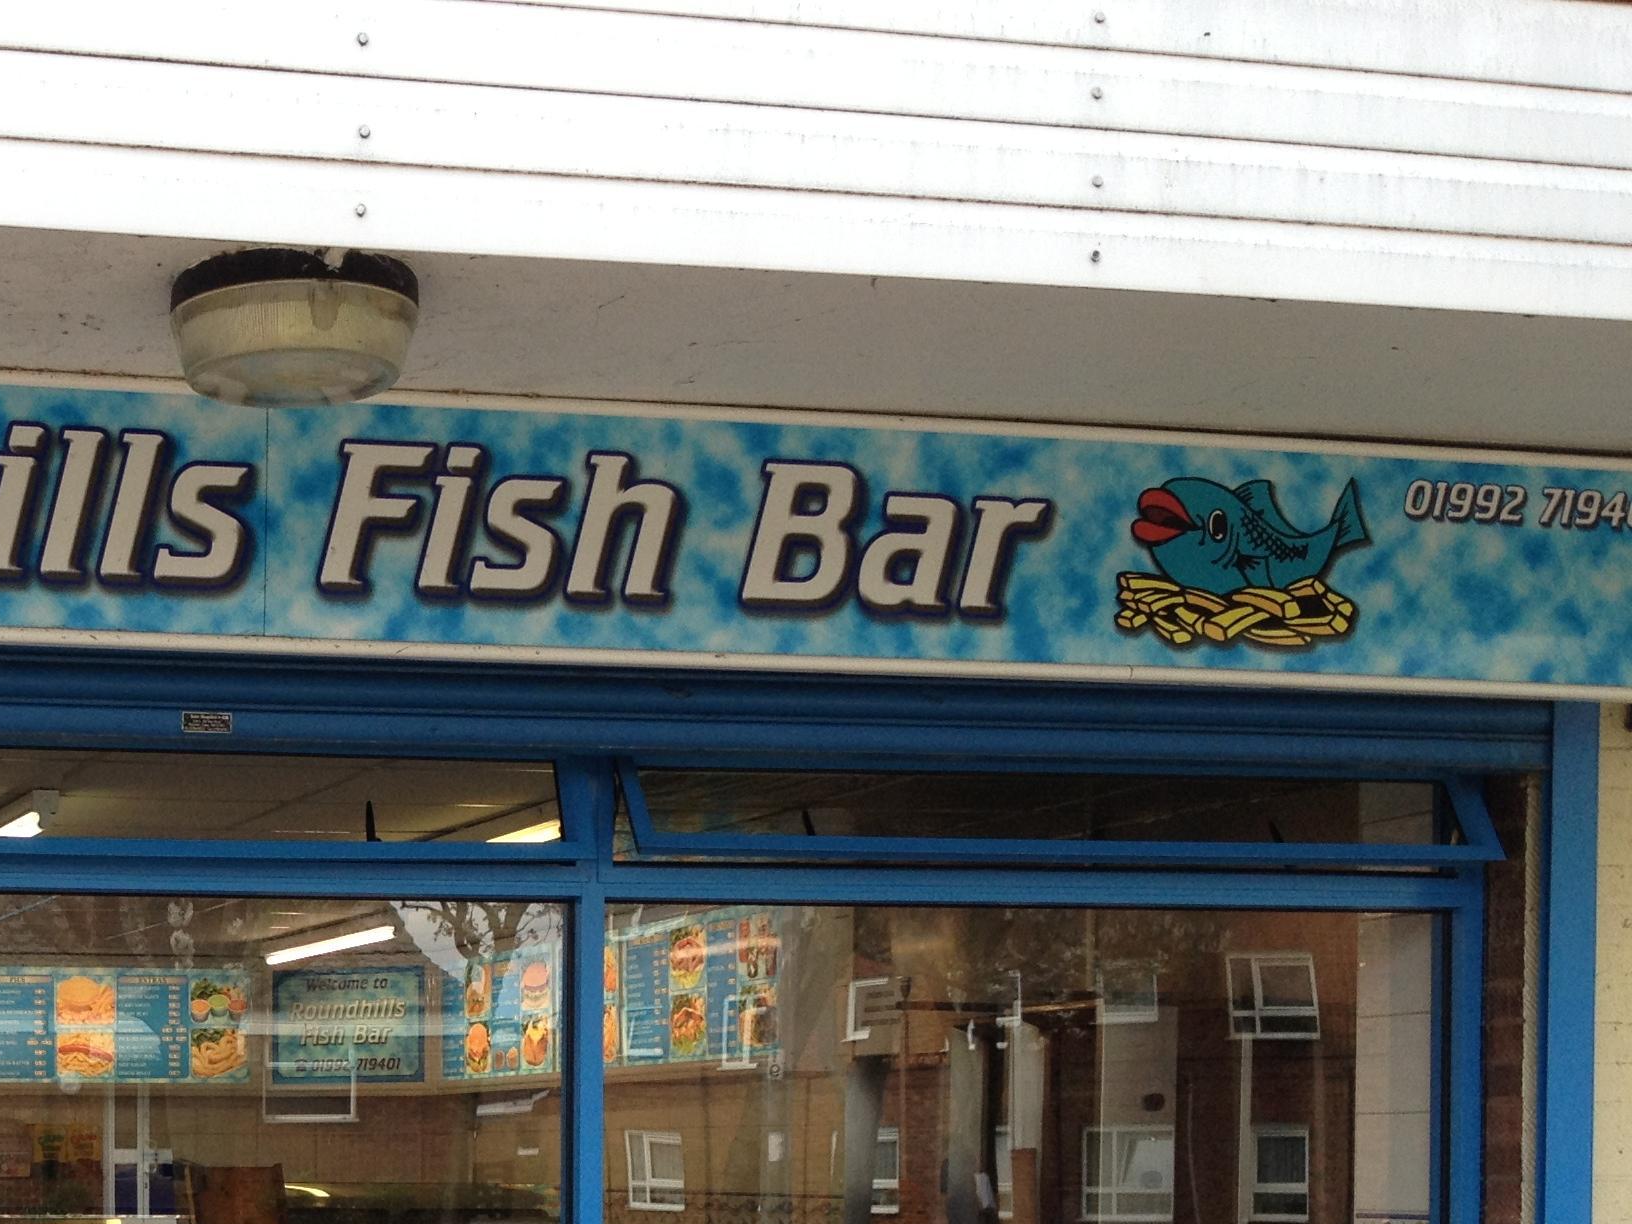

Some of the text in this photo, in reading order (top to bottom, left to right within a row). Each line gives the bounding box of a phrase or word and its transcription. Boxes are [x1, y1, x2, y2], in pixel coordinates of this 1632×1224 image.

[1405, 479, 1632, 530] 01992 7194
[318, 438, 683, 599] Fish
[741, 458, 1050, 614] Bar
[306, 978, 388, 991] Welcome to
[290, 998, 406, 1021] Roundhills
[300, 1022, 392, 1047] Fish Bar
[356, 1057, 401, 1071] 719401
